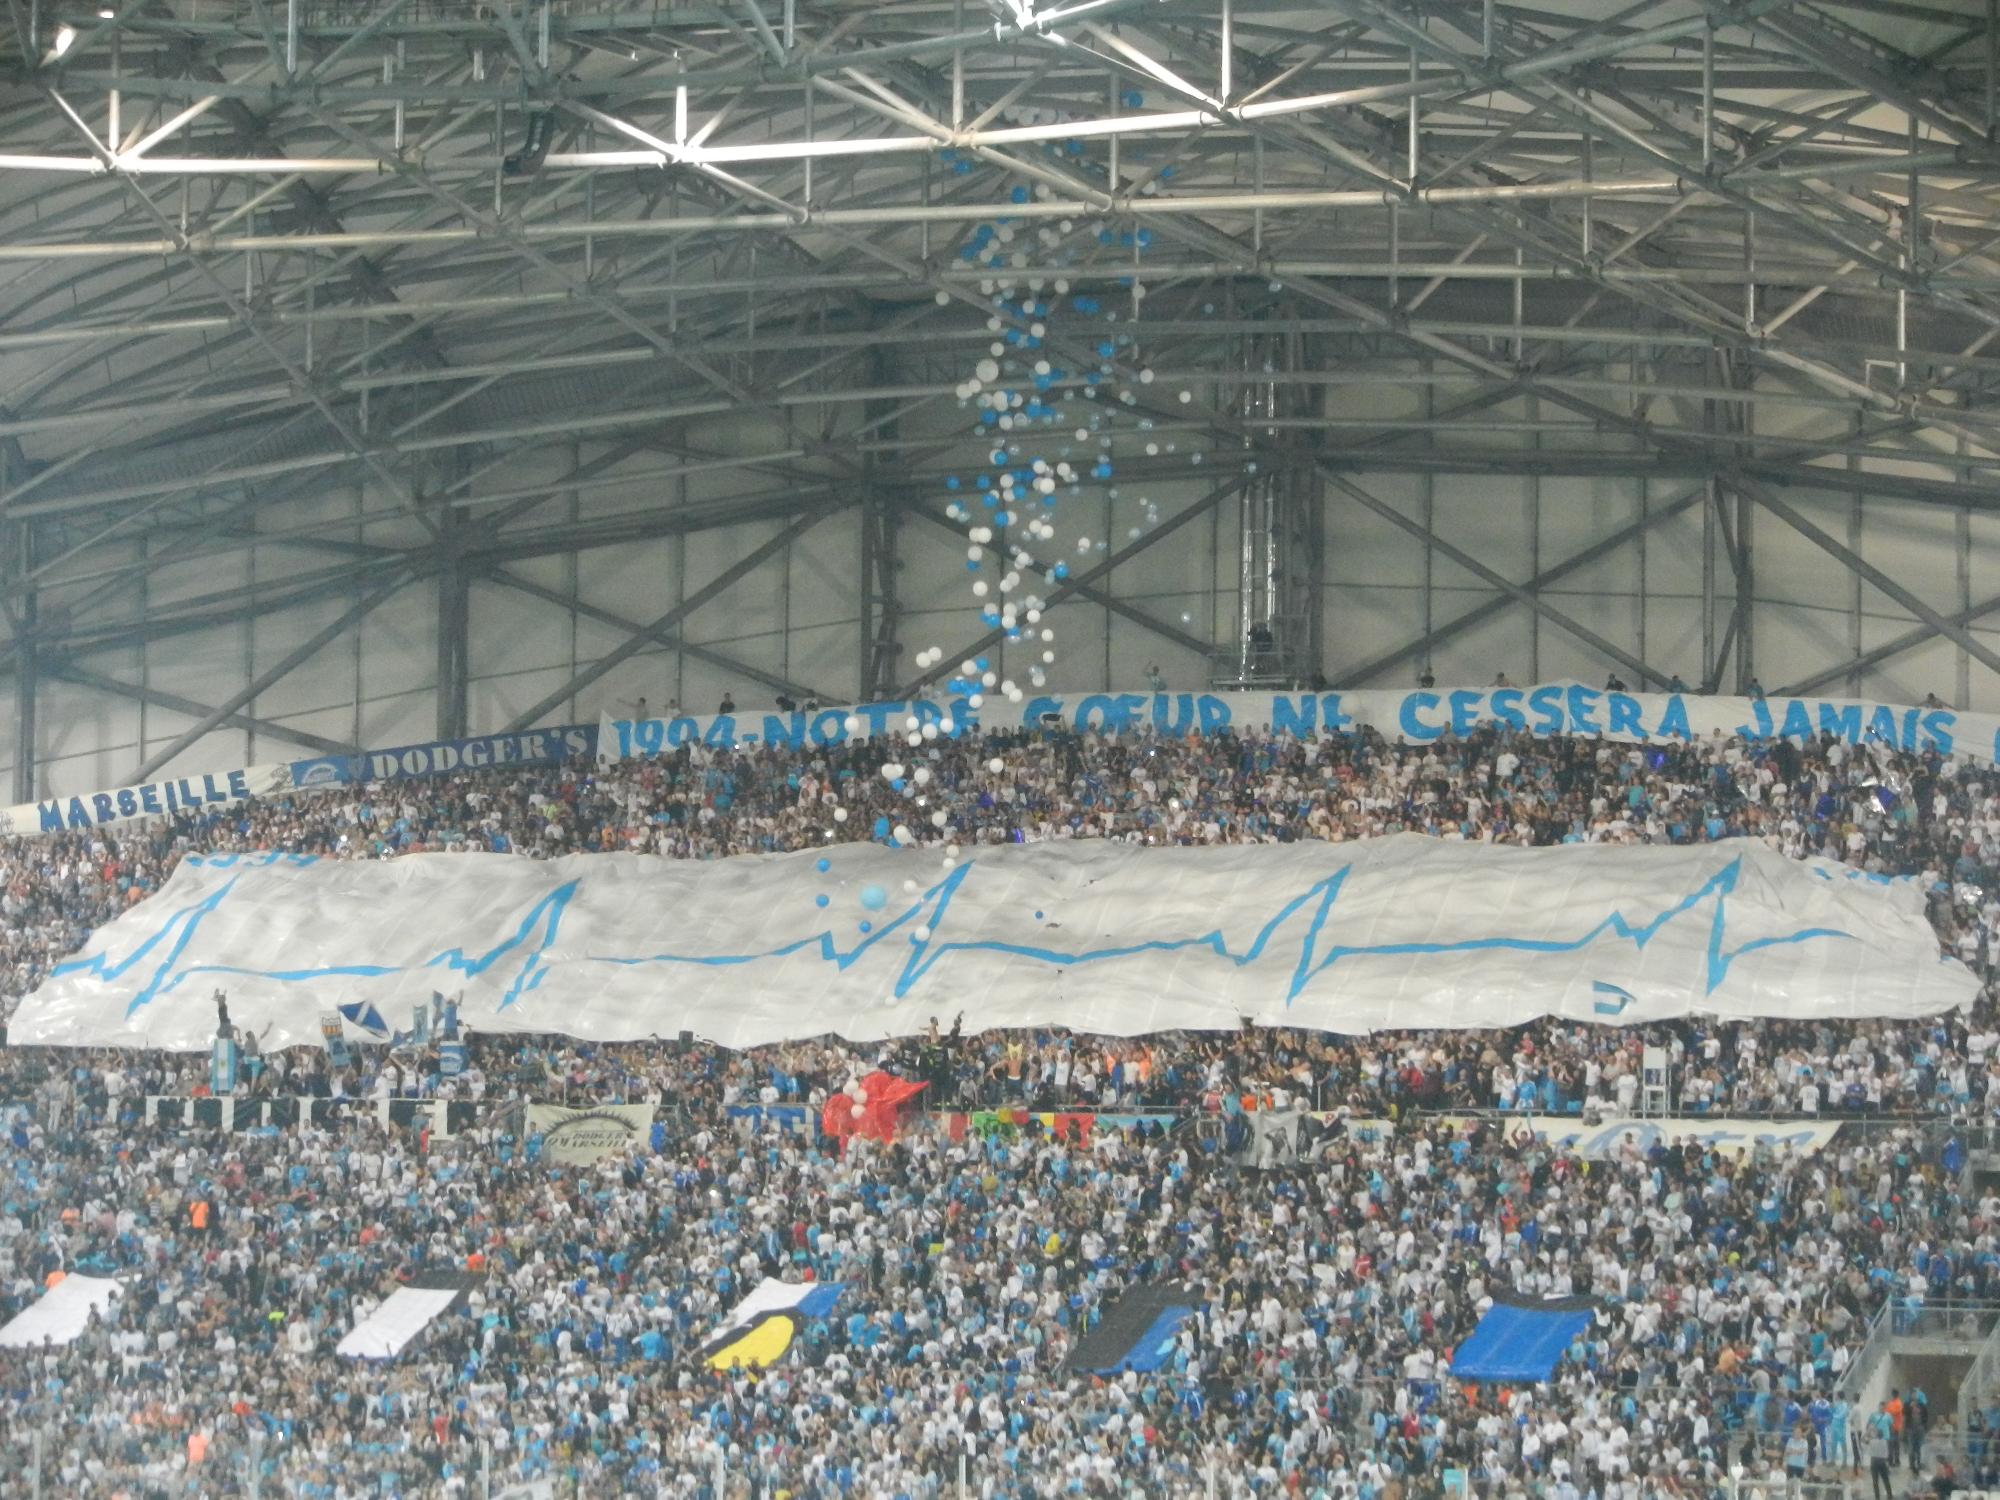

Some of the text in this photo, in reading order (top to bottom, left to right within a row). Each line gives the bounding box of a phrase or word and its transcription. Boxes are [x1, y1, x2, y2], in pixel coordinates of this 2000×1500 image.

[1400, 685, 1692, 742] CESSERA
[1735, 700, 1957, 756] JAMAIS
[372, 729, 589, 780] DODGER'S
[38, 769, 250, 833] MARSEILLE
